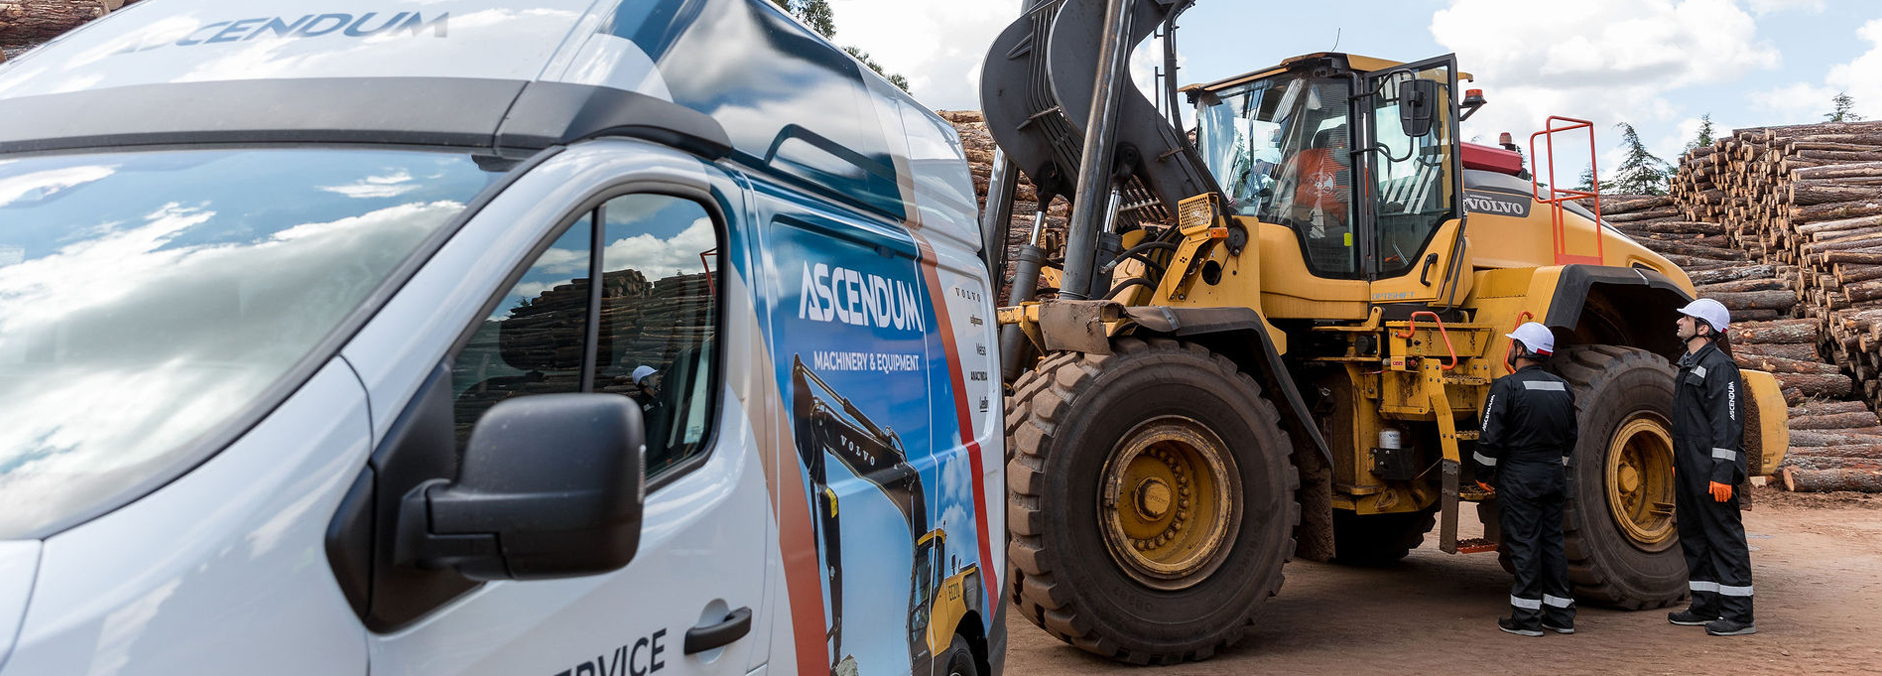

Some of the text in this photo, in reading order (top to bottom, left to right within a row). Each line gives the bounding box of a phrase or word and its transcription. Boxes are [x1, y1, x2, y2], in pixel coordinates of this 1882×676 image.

[1466, 197, 1524, 215] VOLVO
[799, 260, 923, 332] ASCENDUM
[955, 287, 981, 303] VOLVO
[813, 351, 919, 374] MACHINERY & EQUIPMENT
[840, 434, 875, 467] VOLVO
[552, 627, 667, 676] VICE
